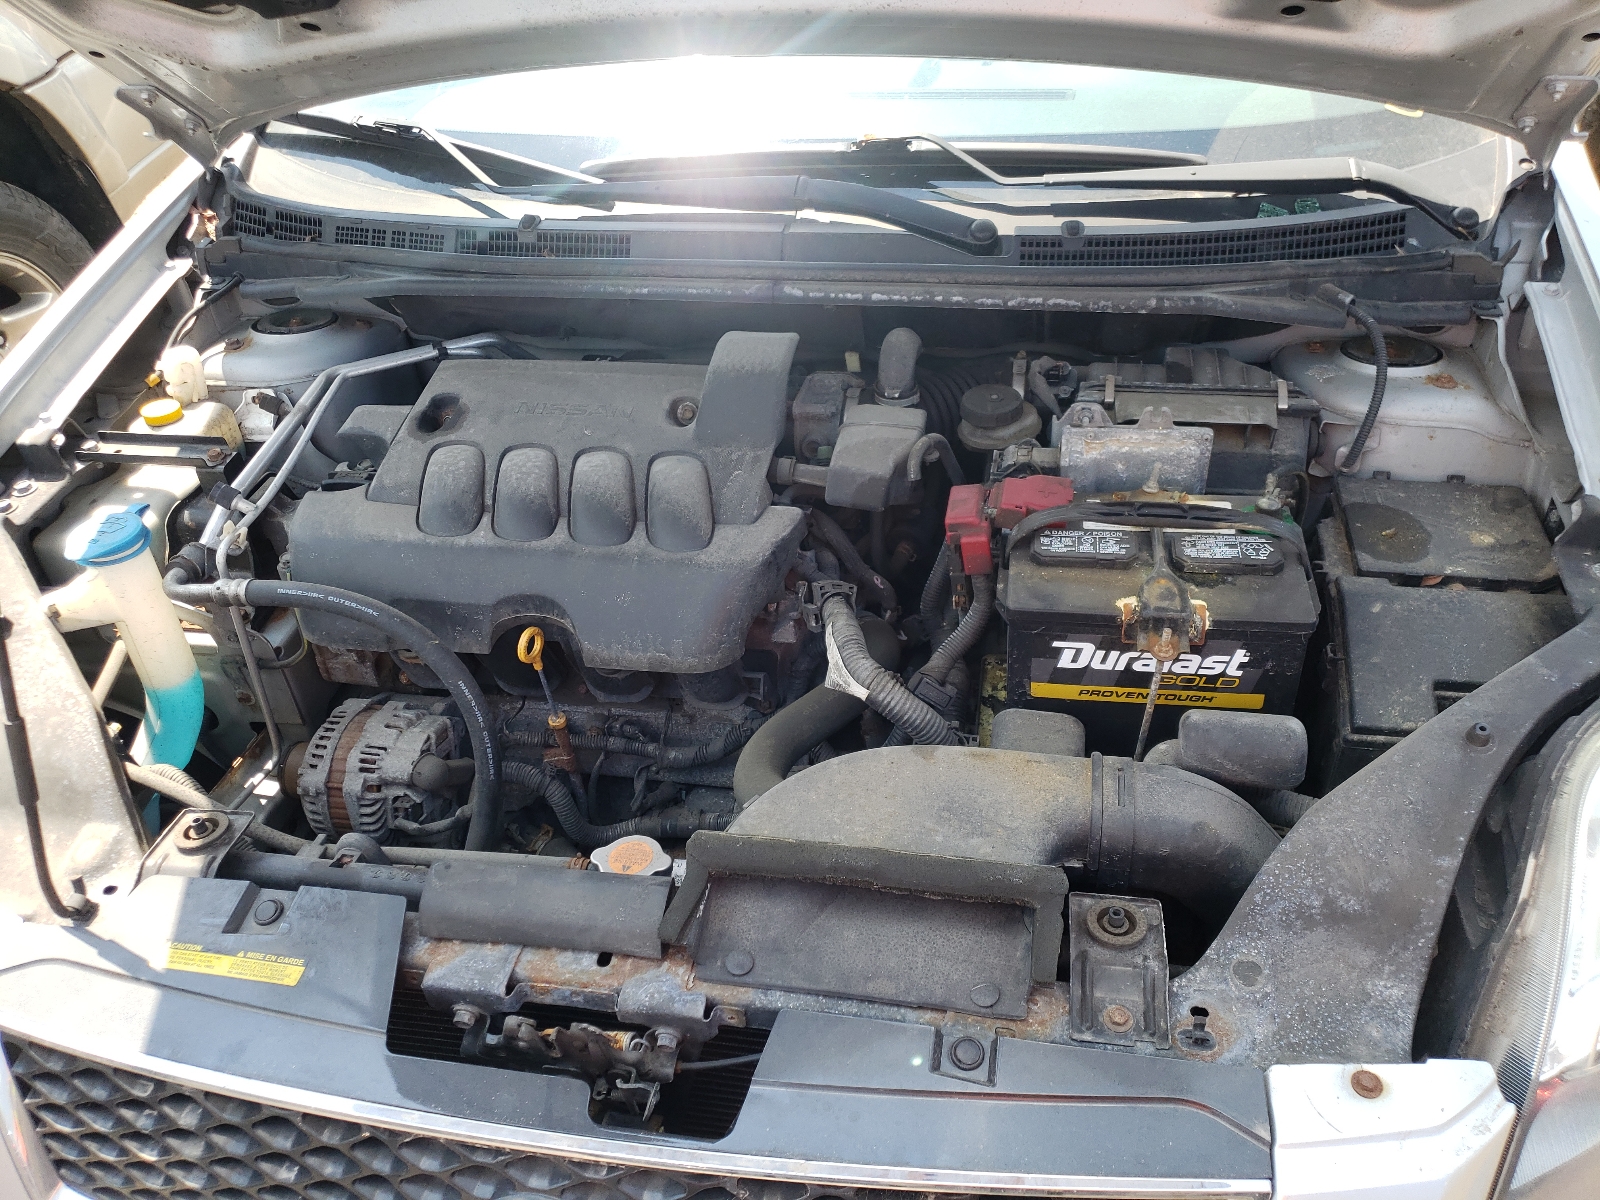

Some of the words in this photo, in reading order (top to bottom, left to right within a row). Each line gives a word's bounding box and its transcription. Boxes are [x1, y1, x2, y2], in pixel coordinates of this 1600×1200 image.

[514, 401, 635, 419] NISSAN
[1078, 689, 1149, 700] PROVEN
[1156, 693, 1216, 703] TOUGH
[171, 942, 204, 951] CAUTION
[245, 951, 265, 960] MISE
[277, 956, 304, 966] GARDE
